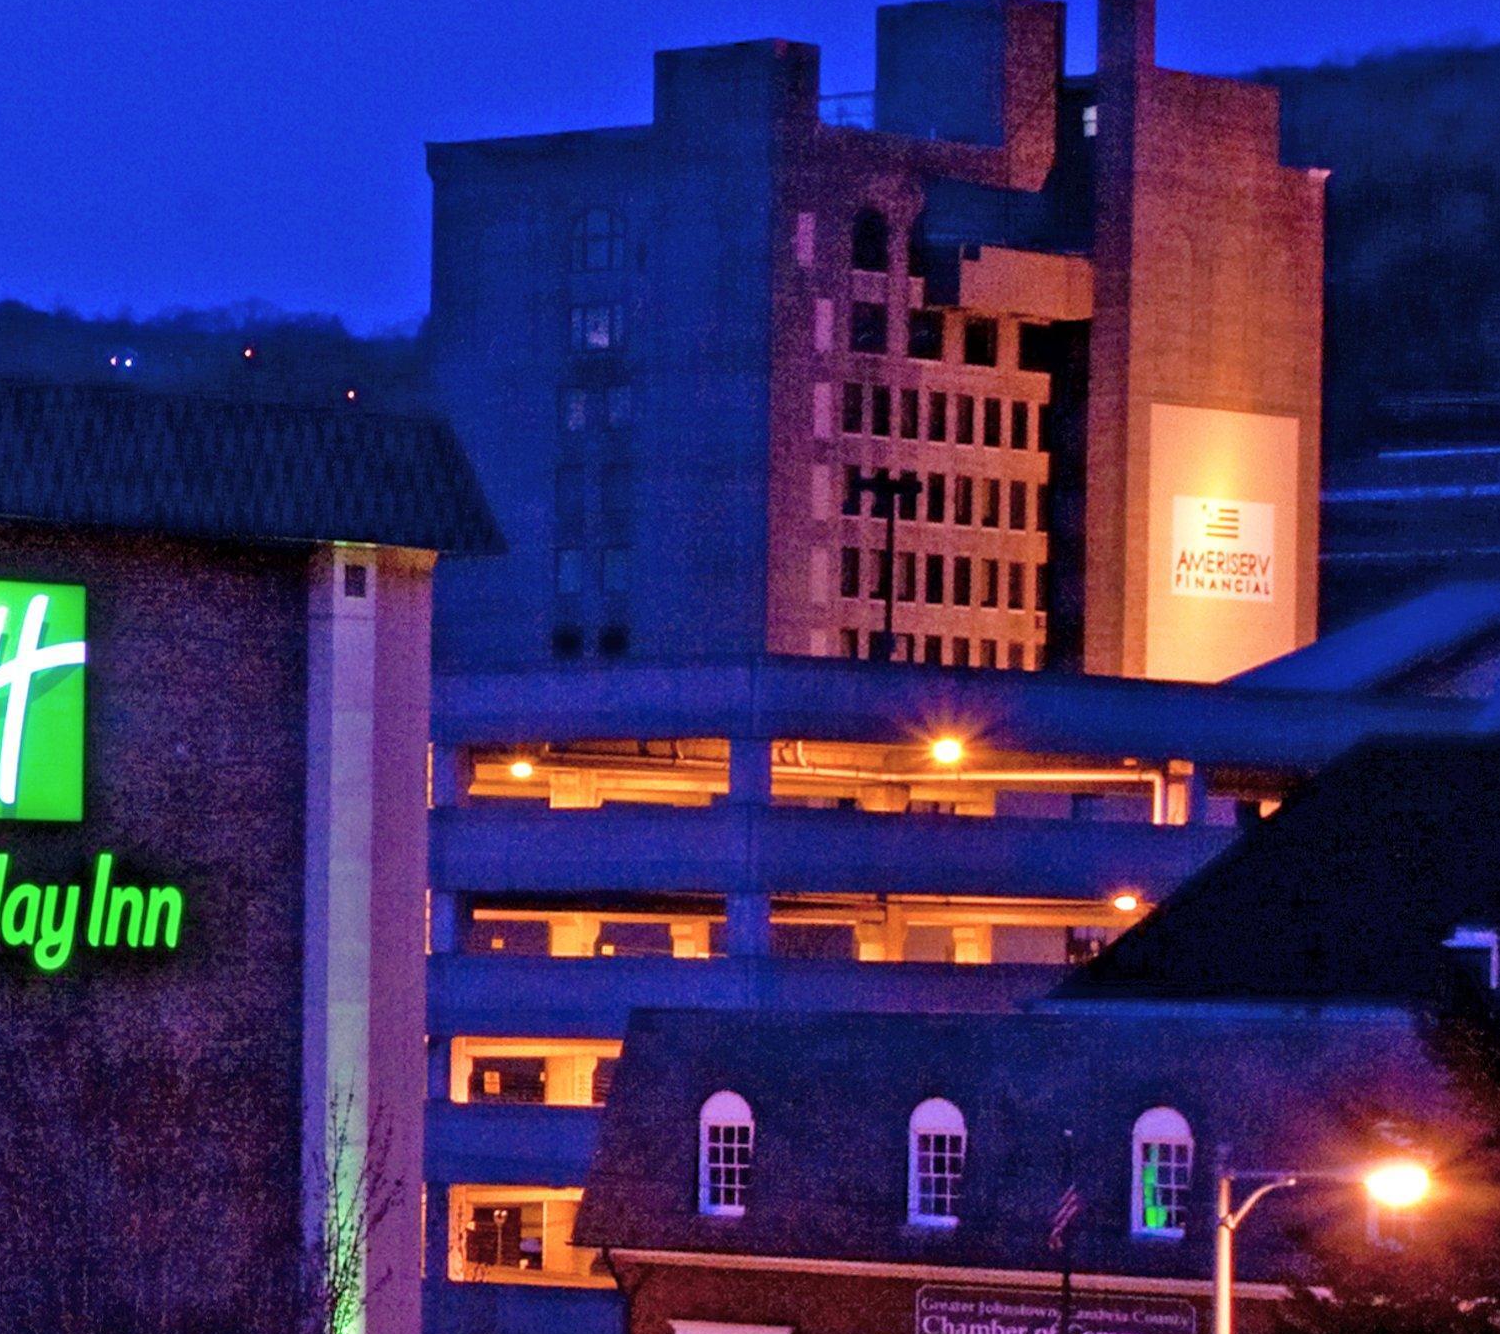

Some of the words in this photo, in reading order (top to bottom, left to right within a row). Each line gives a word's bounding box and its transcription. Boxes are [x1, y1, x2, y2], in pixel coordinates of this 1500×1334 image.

[1176, 550, 1271, 577] AMERISERV
[1175, 574, 1270, 595] FINANCIAL
[88, 853, 184, 949] Inn
